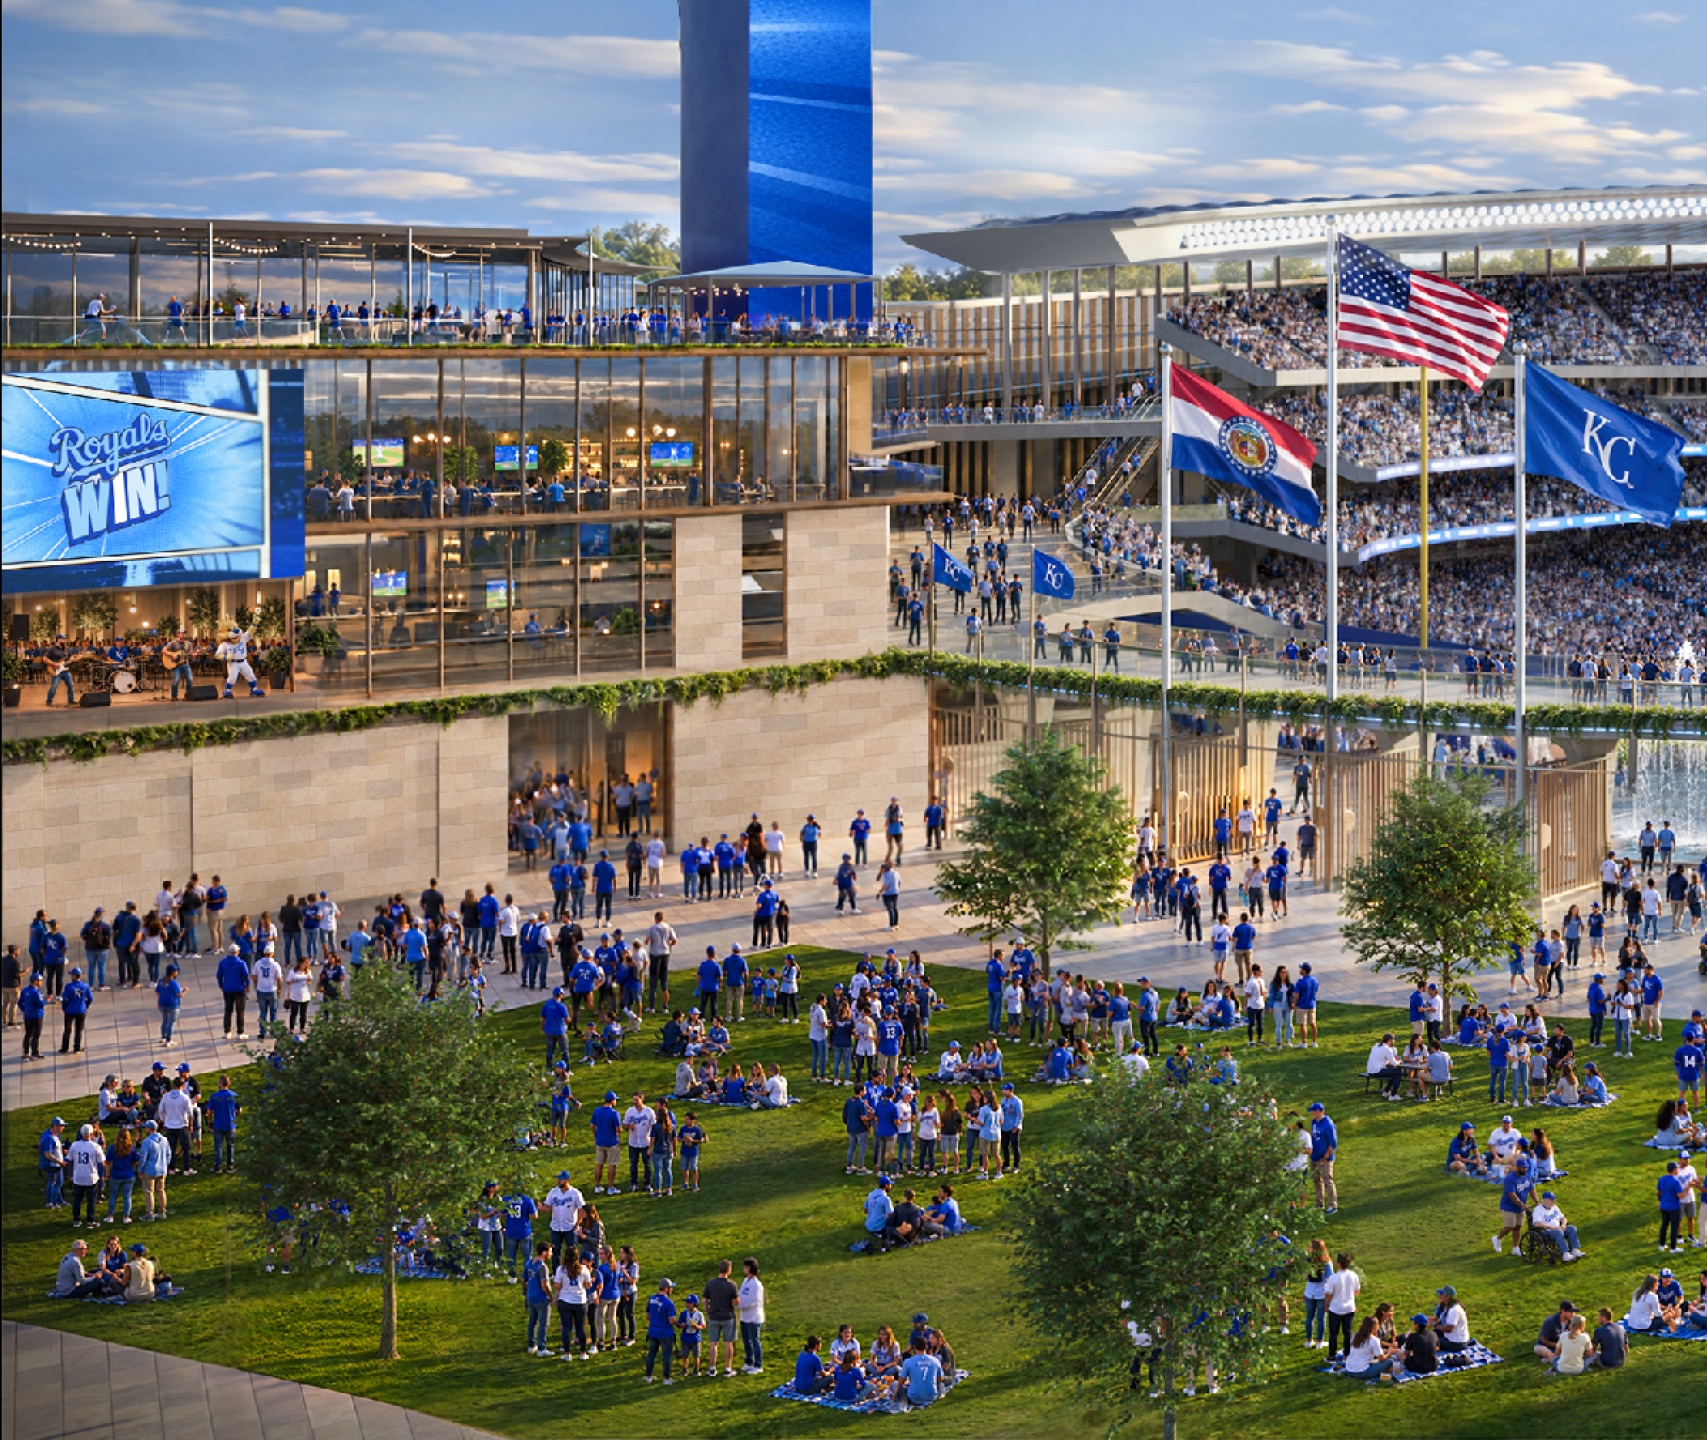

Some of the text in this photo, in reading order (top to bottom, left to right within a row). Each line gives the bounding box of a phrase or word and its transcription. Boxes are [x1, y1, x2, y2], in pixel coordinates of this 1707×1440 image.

[50, 413, 172, 479] Royals
[1581, 408, 1637, 489] KC
[62, 459, 171, 547] WIN!
[1044, 563, 1063, 590] KC
[1685, 1055, 1697, 1068] 14
[77, 1152, 90, 1165] 13
[920, 1367, 929, 1381] 7
